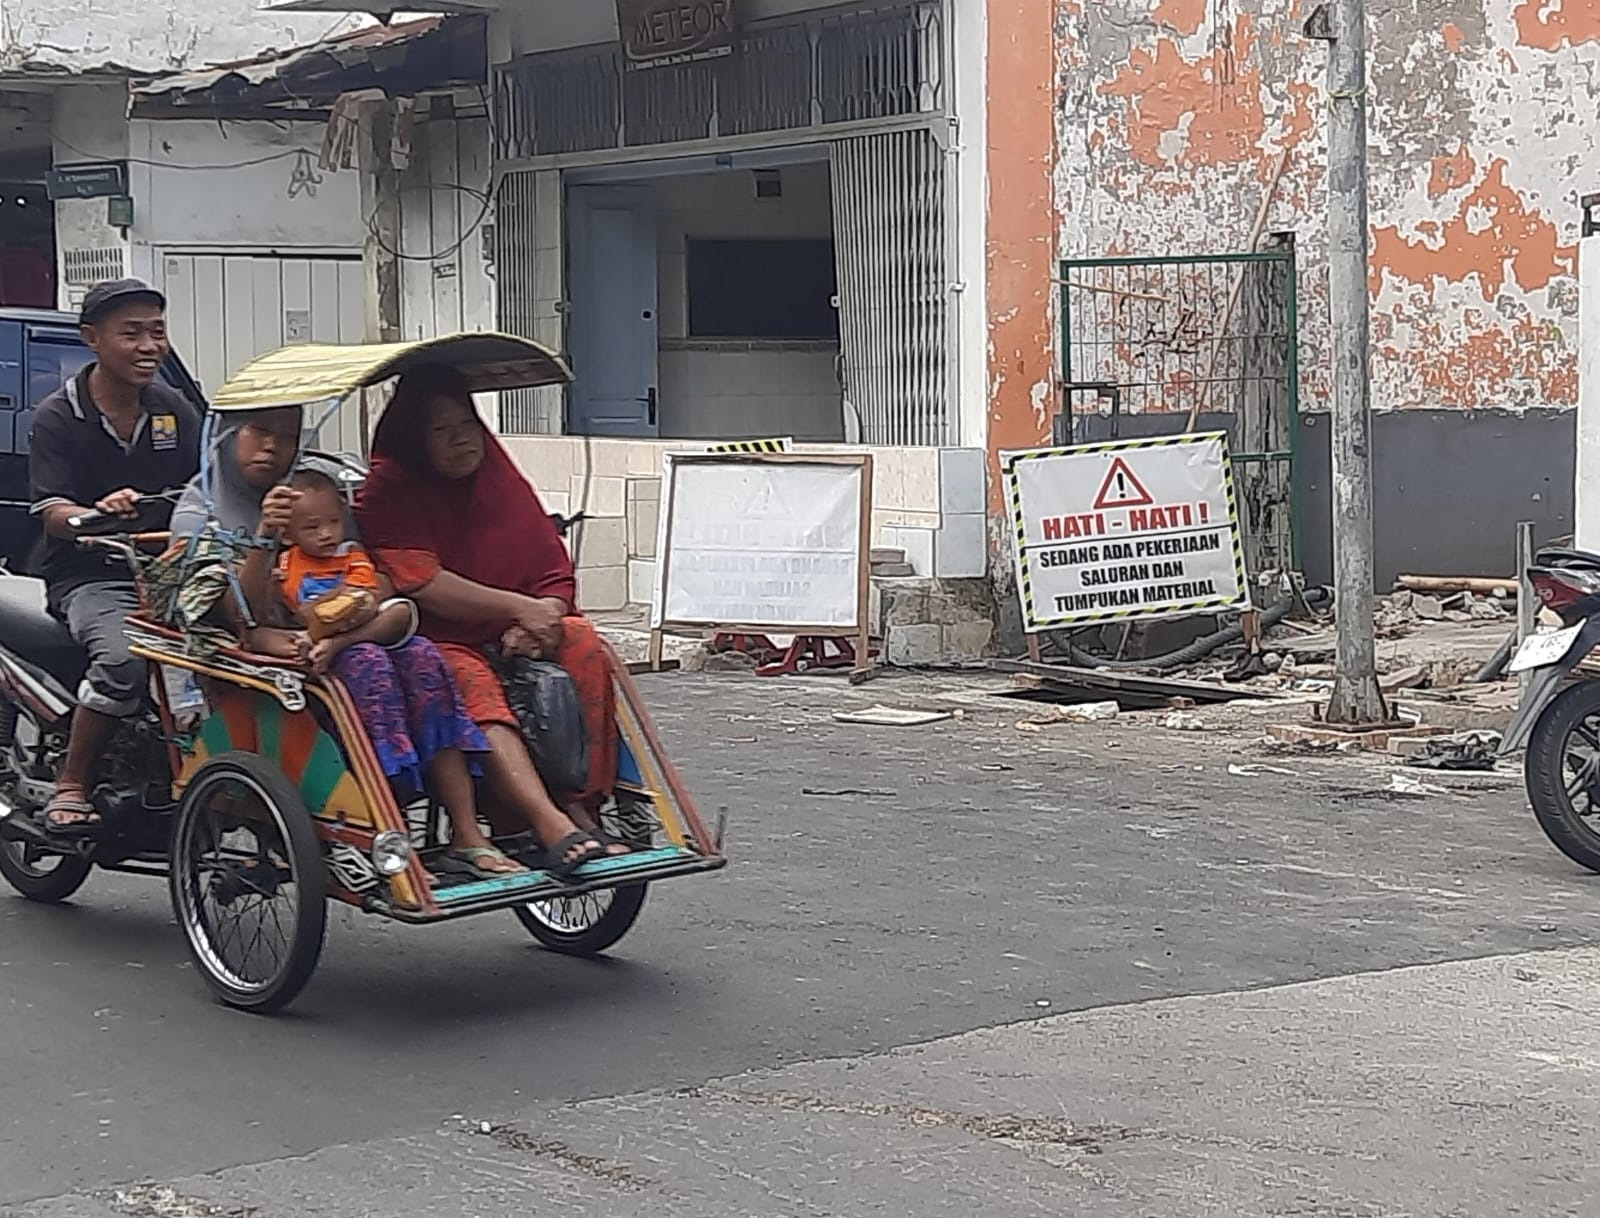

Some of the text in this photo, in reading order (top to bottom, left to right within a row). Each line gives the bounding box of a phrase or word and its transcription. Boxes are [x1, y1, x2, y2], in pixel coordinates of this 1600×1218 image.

[634, 2, 732, 45] METEOR
[1043, 514, 1105, 540] HATI
[1129, 505, 1191, 531] HATI
[1040, 533, 1219, 567] SEDANG ADA PEKERJAAN
[1081, 560, 1184, 586] SALURAN DAN
[1055, 579, 1216, 612] TUMPUKAN MATERIAL
